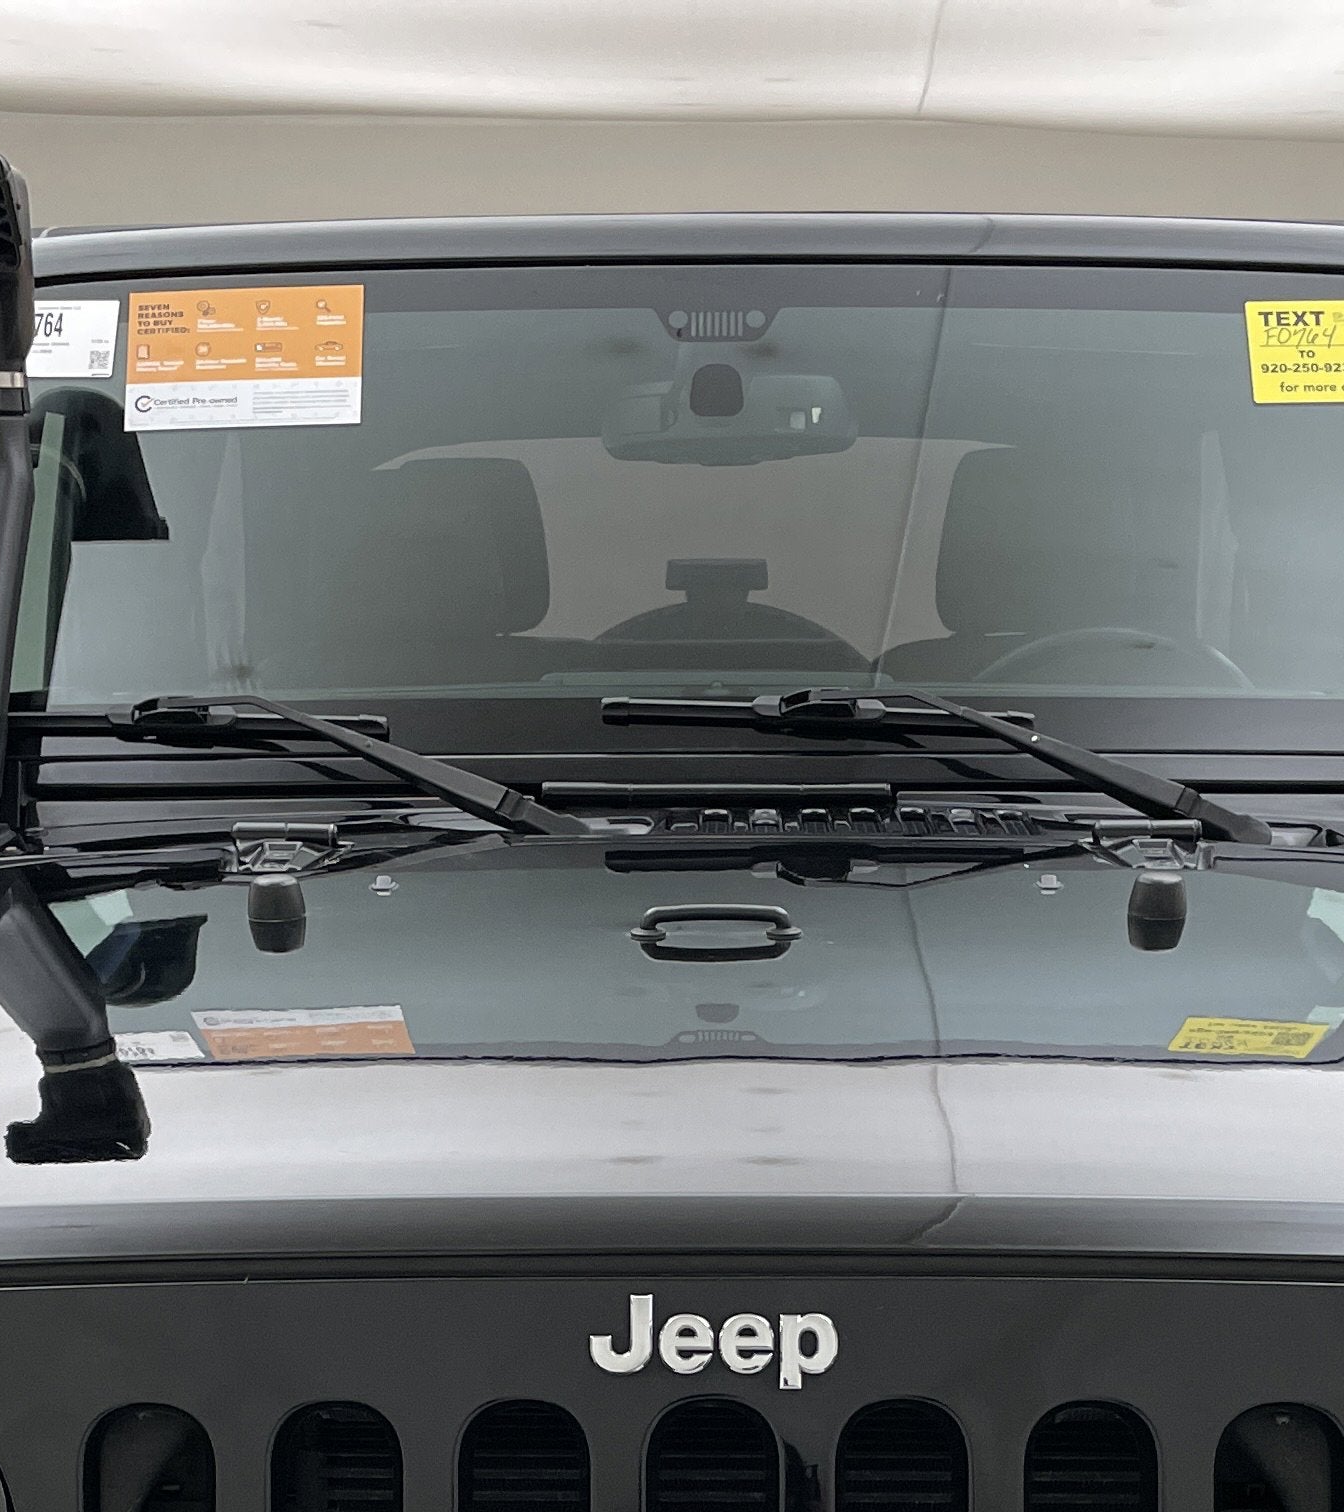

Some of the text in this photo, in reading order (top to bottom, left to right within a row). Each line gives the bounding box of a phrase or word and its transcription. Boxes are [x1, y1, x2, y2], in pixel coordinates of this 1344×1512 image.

[138, 303, 170, 311] SEVEN
[137, 311, 184, 319] REASONS
[1258, 311, 1325, 327] TEXT
[1299, 350, 1316, 358] TO
[1279, 381, 1300, 392] for
[1303, 384, 1337, 392] more
[589, 1293, 840, 1390] Jeep
